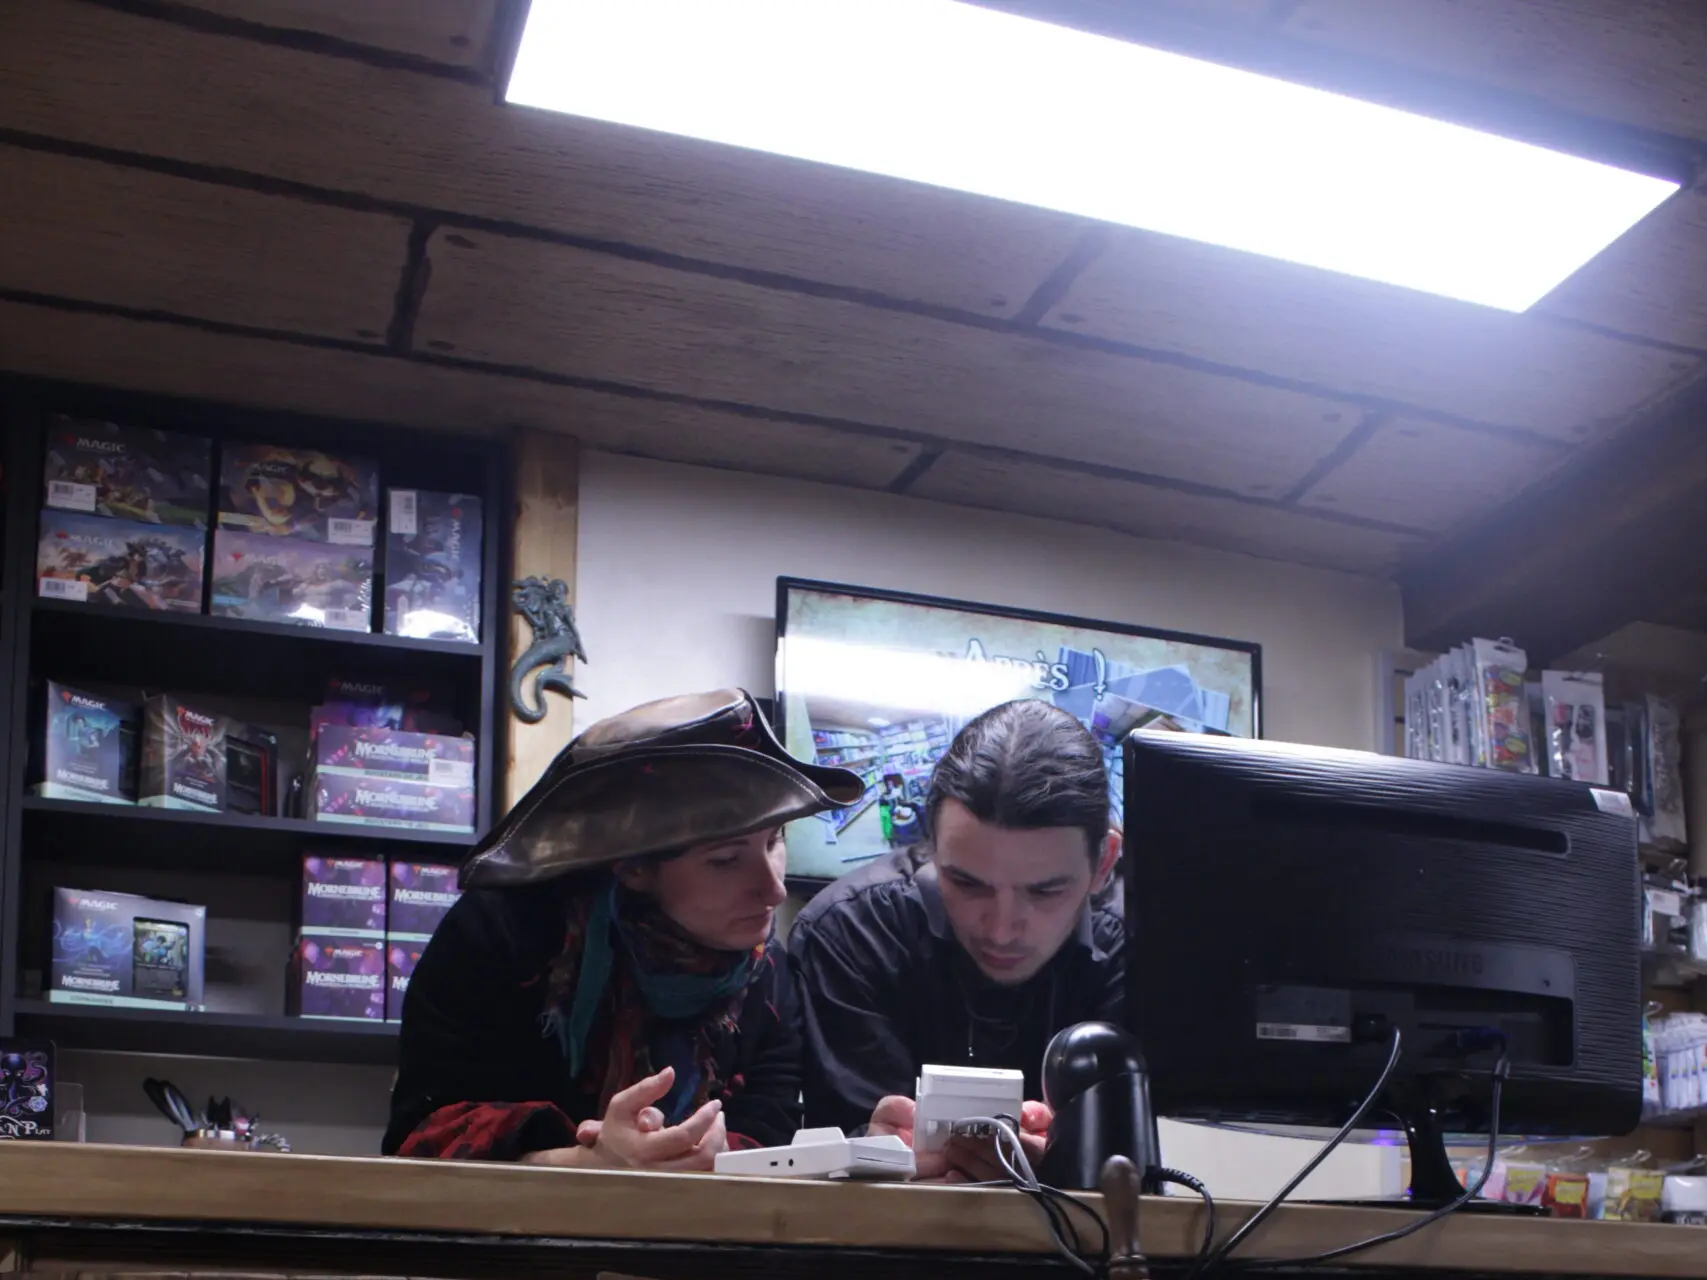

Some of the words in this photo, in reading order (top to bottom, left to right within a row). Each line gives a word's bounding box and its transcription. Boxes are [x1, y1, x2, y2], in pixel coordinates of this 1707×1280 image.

[76, 437, 126, 453] MAGIC
[340, 680, 386, 696] MAGIC
[71, 695, 106, 710] MAGIC
[79, 898, 119, 910] MAGIC
